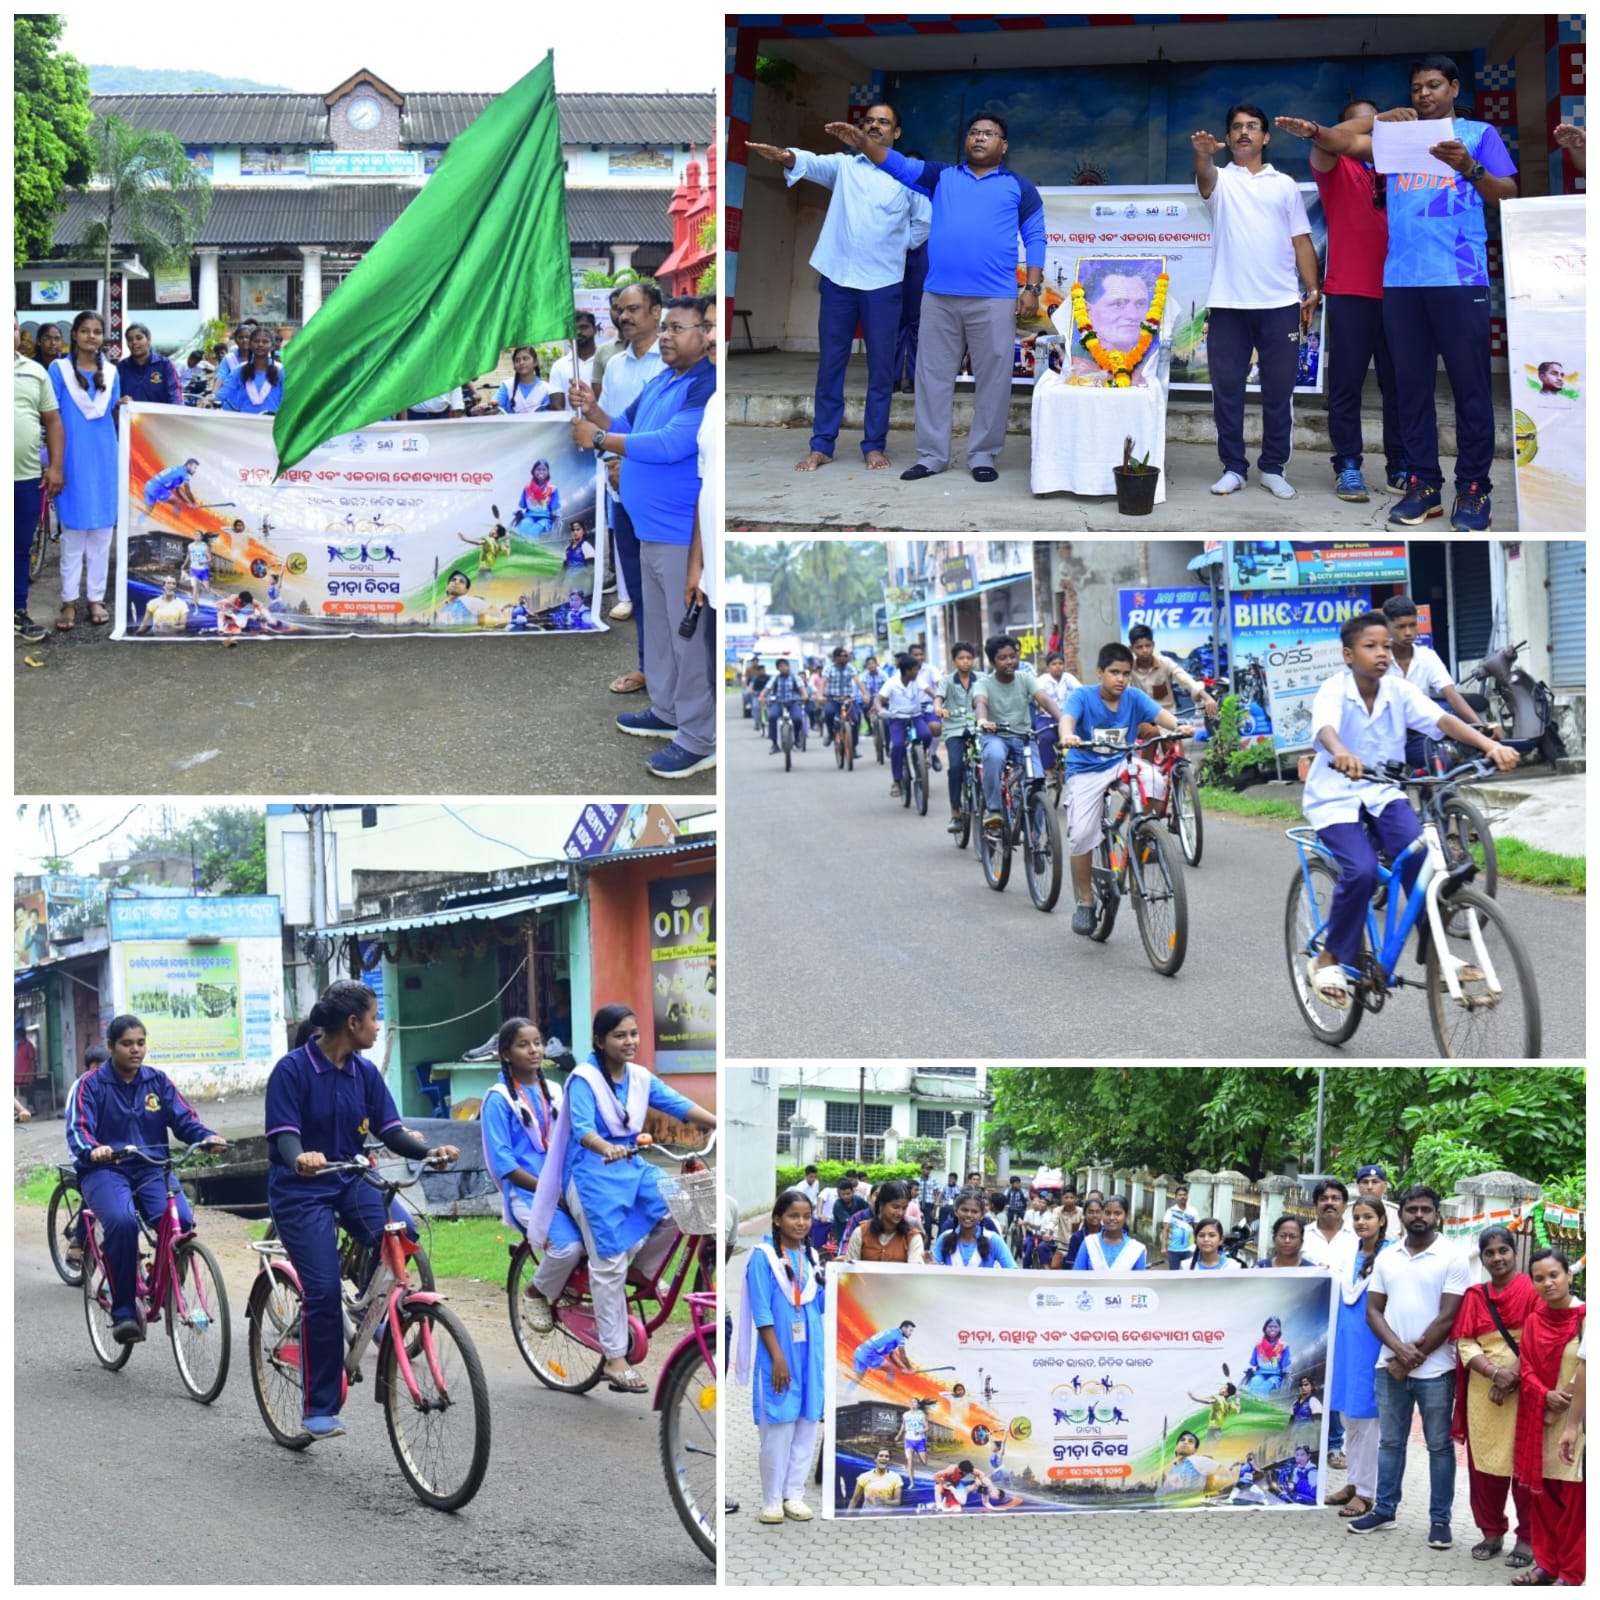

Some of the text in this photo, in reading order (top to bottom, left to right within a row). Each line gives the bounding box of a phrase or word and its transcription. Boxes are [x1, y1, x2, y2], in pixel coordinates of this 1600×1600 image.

[1395, 173, 1457, 192] NDIA
[1128, 608, 1183, 630] BIKE
[1235, 603, 1292, 627] BIKE
